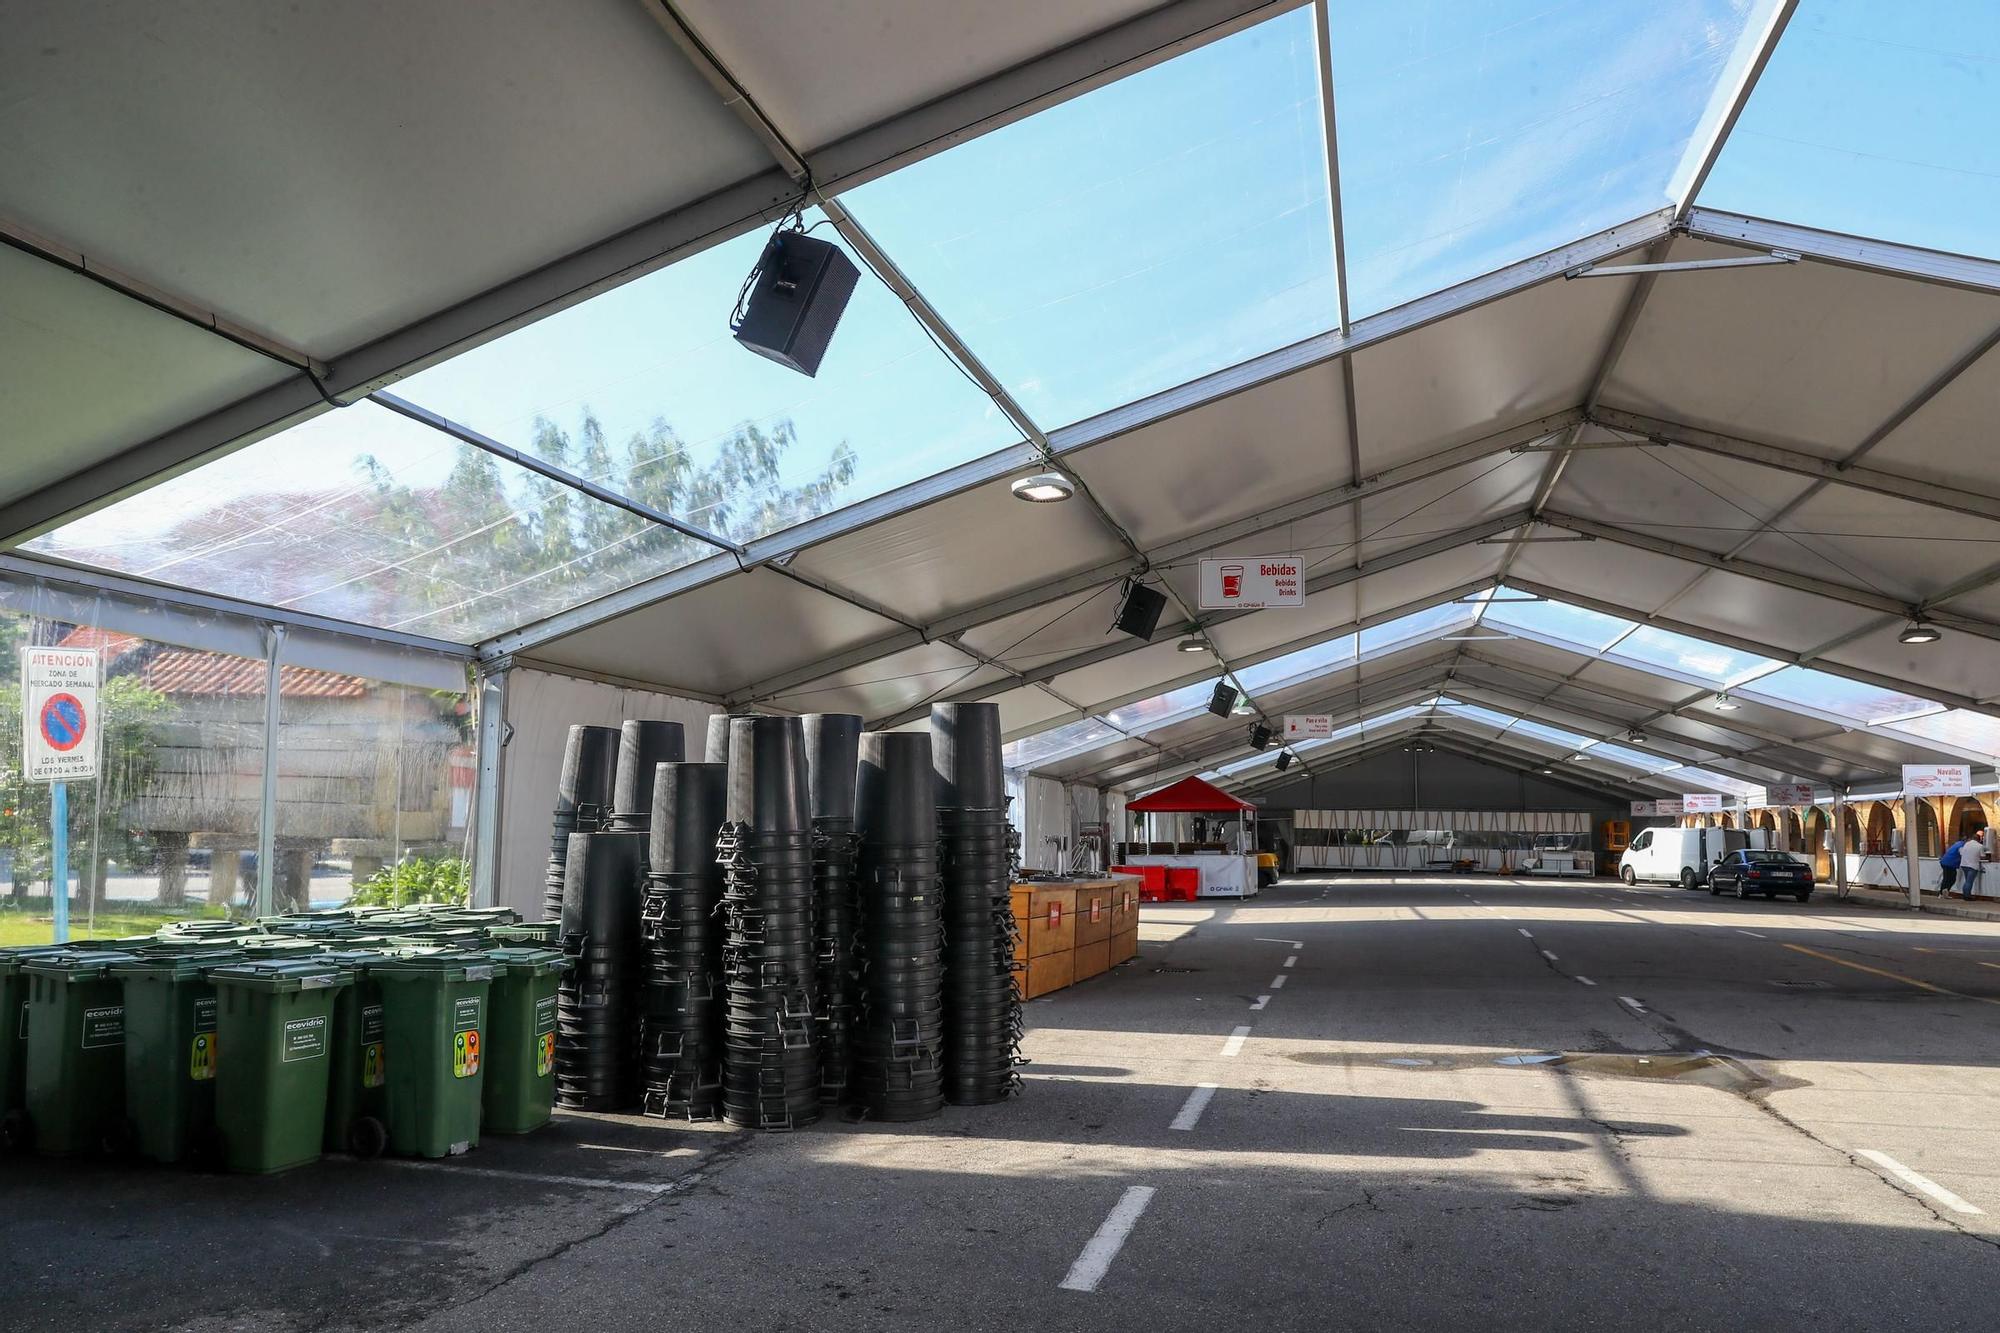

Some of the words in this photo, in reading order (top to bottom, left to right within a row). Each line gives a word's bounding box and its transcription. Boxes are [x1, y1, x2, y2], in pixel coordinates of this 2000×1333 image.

[1260, 563, 1297, 576] Bebidas
[1275, 579, 1297, 587] Bebidas
[48, 670, 67, 678] ZONA
[69, 670, 78, 678] DE
[30, 679, 63, 688] MERCADO
[65, 680, 95, 689] SEMANAL
[1937, 768, 1962, 776] Navallas
[86, 1008, 124, 1018] ecovidr
[286, 1018, 324, 1030] ecovidrio
